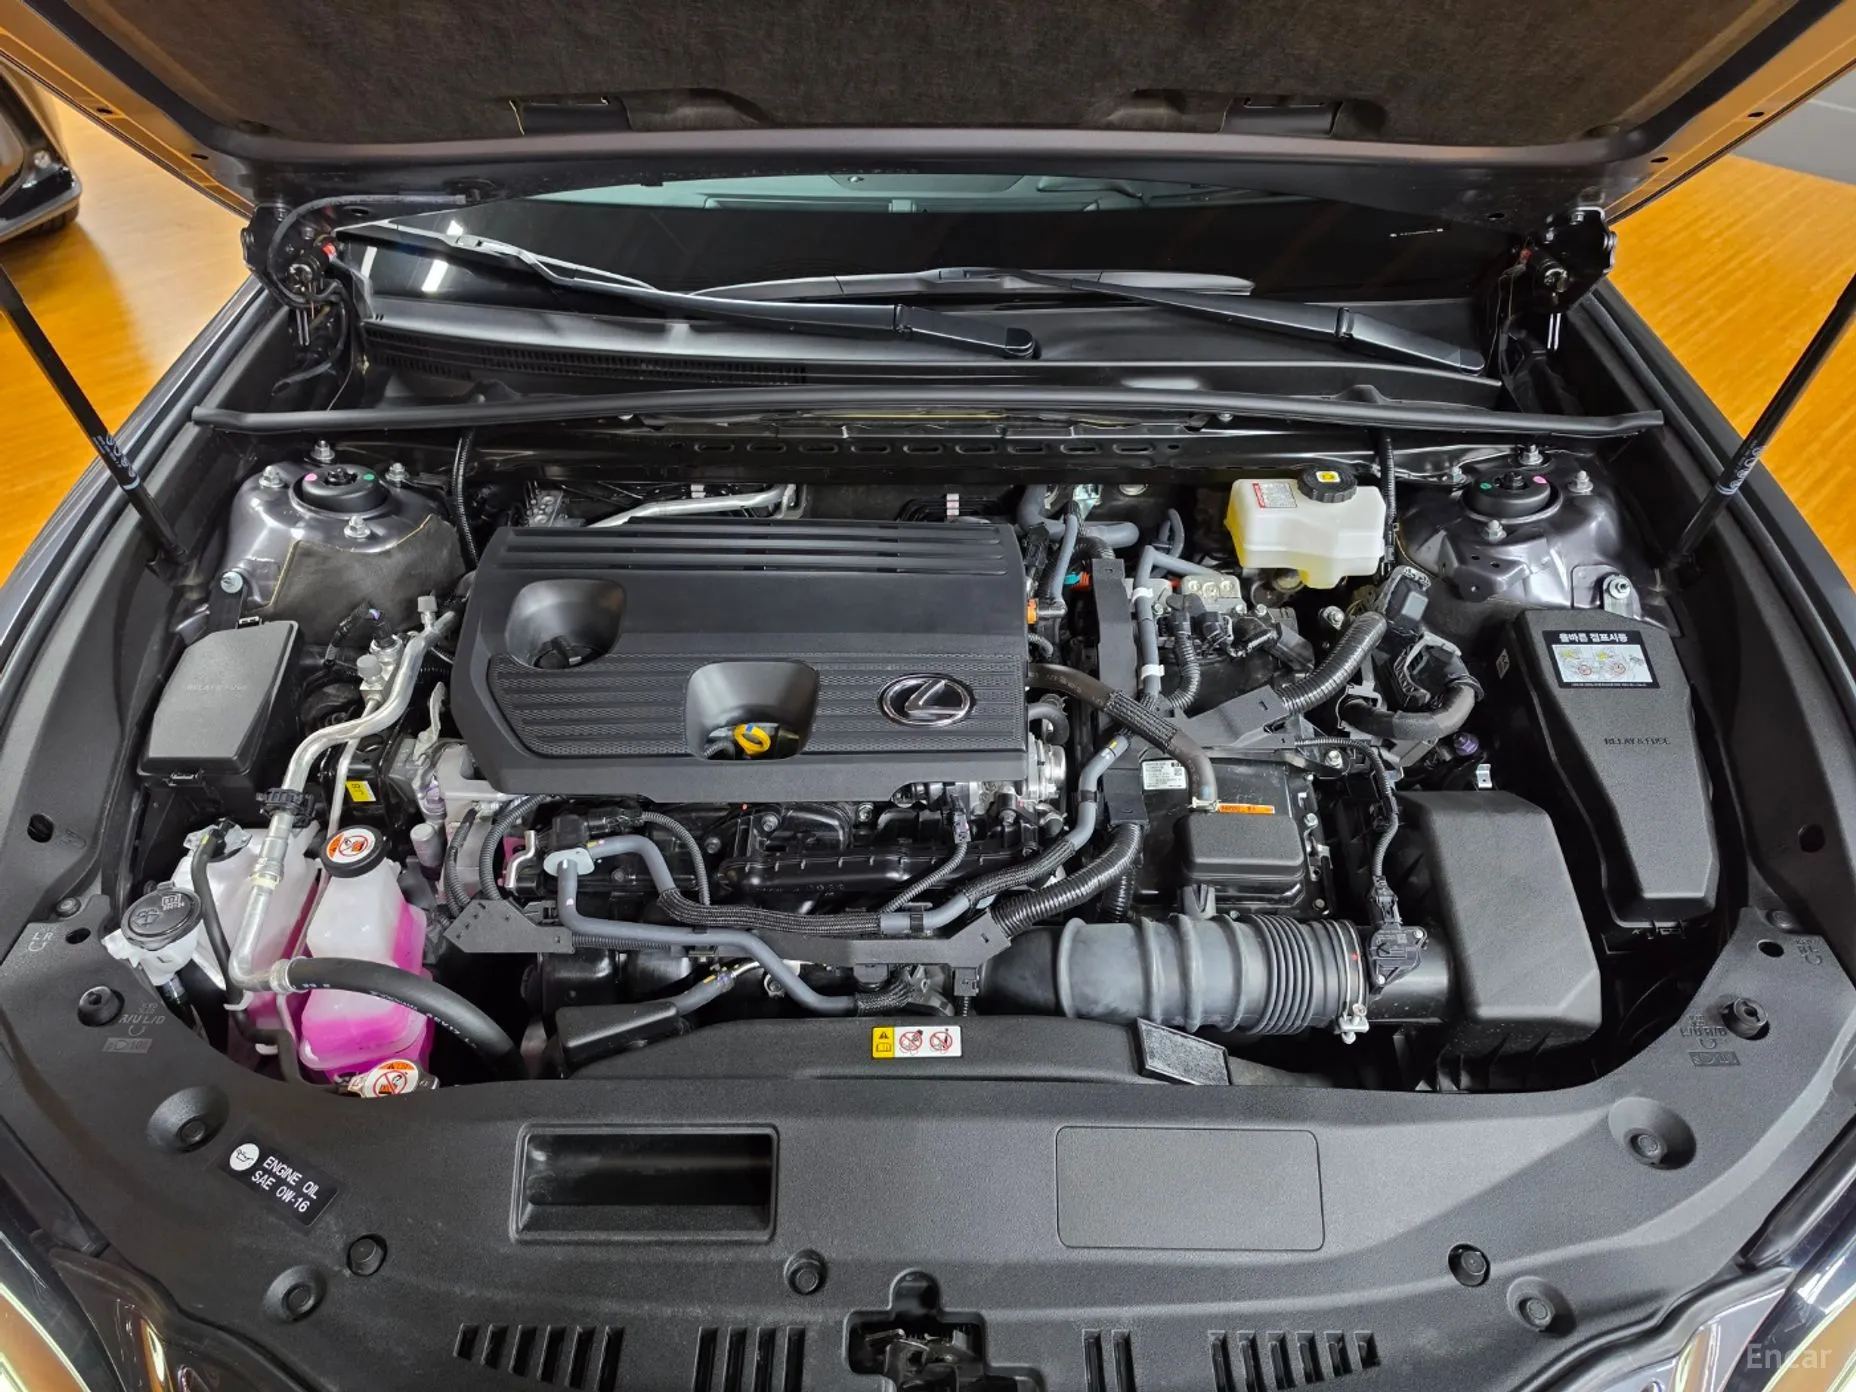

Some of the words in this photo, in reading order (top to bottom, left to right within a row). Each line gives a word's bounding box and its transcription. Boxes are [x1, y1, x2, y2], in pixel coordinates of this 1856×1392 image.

[251, 1170, 276, 1191] SAE
[262, 1155, 303, 1186] ENGINE
[302, 1181, 320, 1200] OIL
